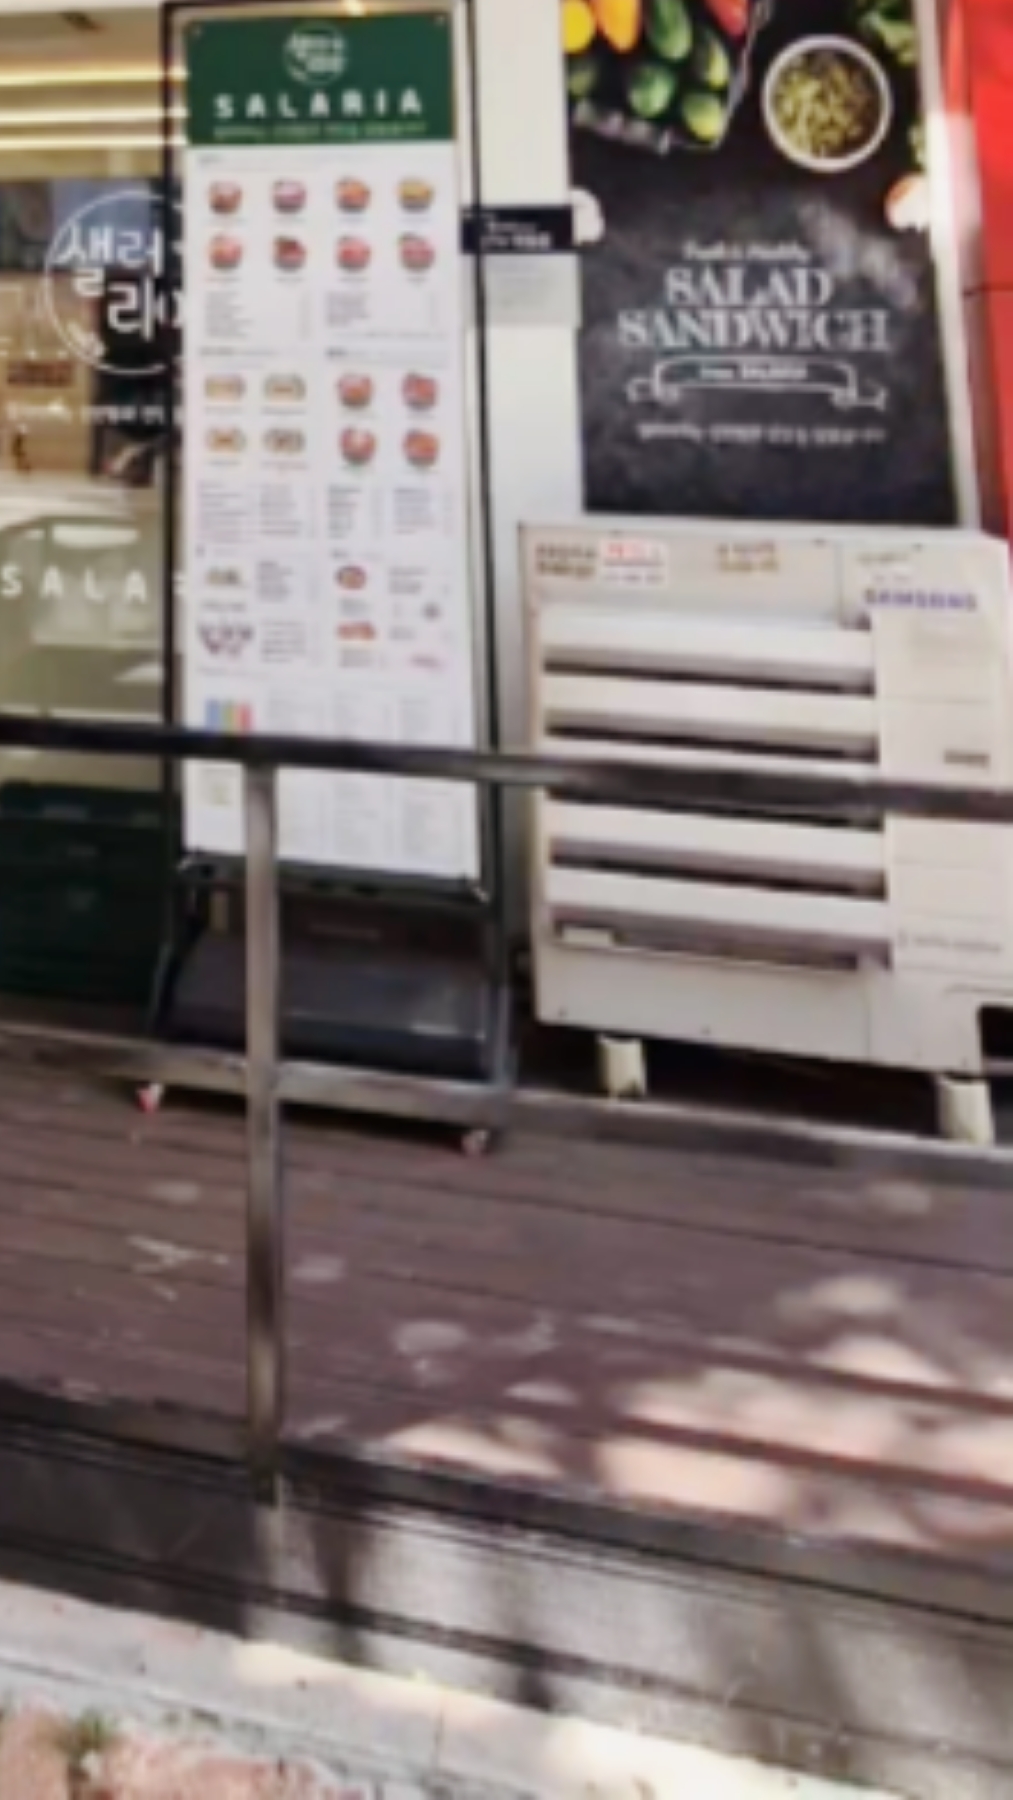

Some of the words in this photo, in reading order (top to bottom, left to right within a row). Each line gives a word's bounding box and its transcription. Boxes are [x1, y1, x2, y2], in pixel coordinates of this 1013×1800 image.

[212, 86, 423, 119] SALARIA
[663, 264, 833, 307] SALAD
[616, 308, 890, 350] SANDWICH
